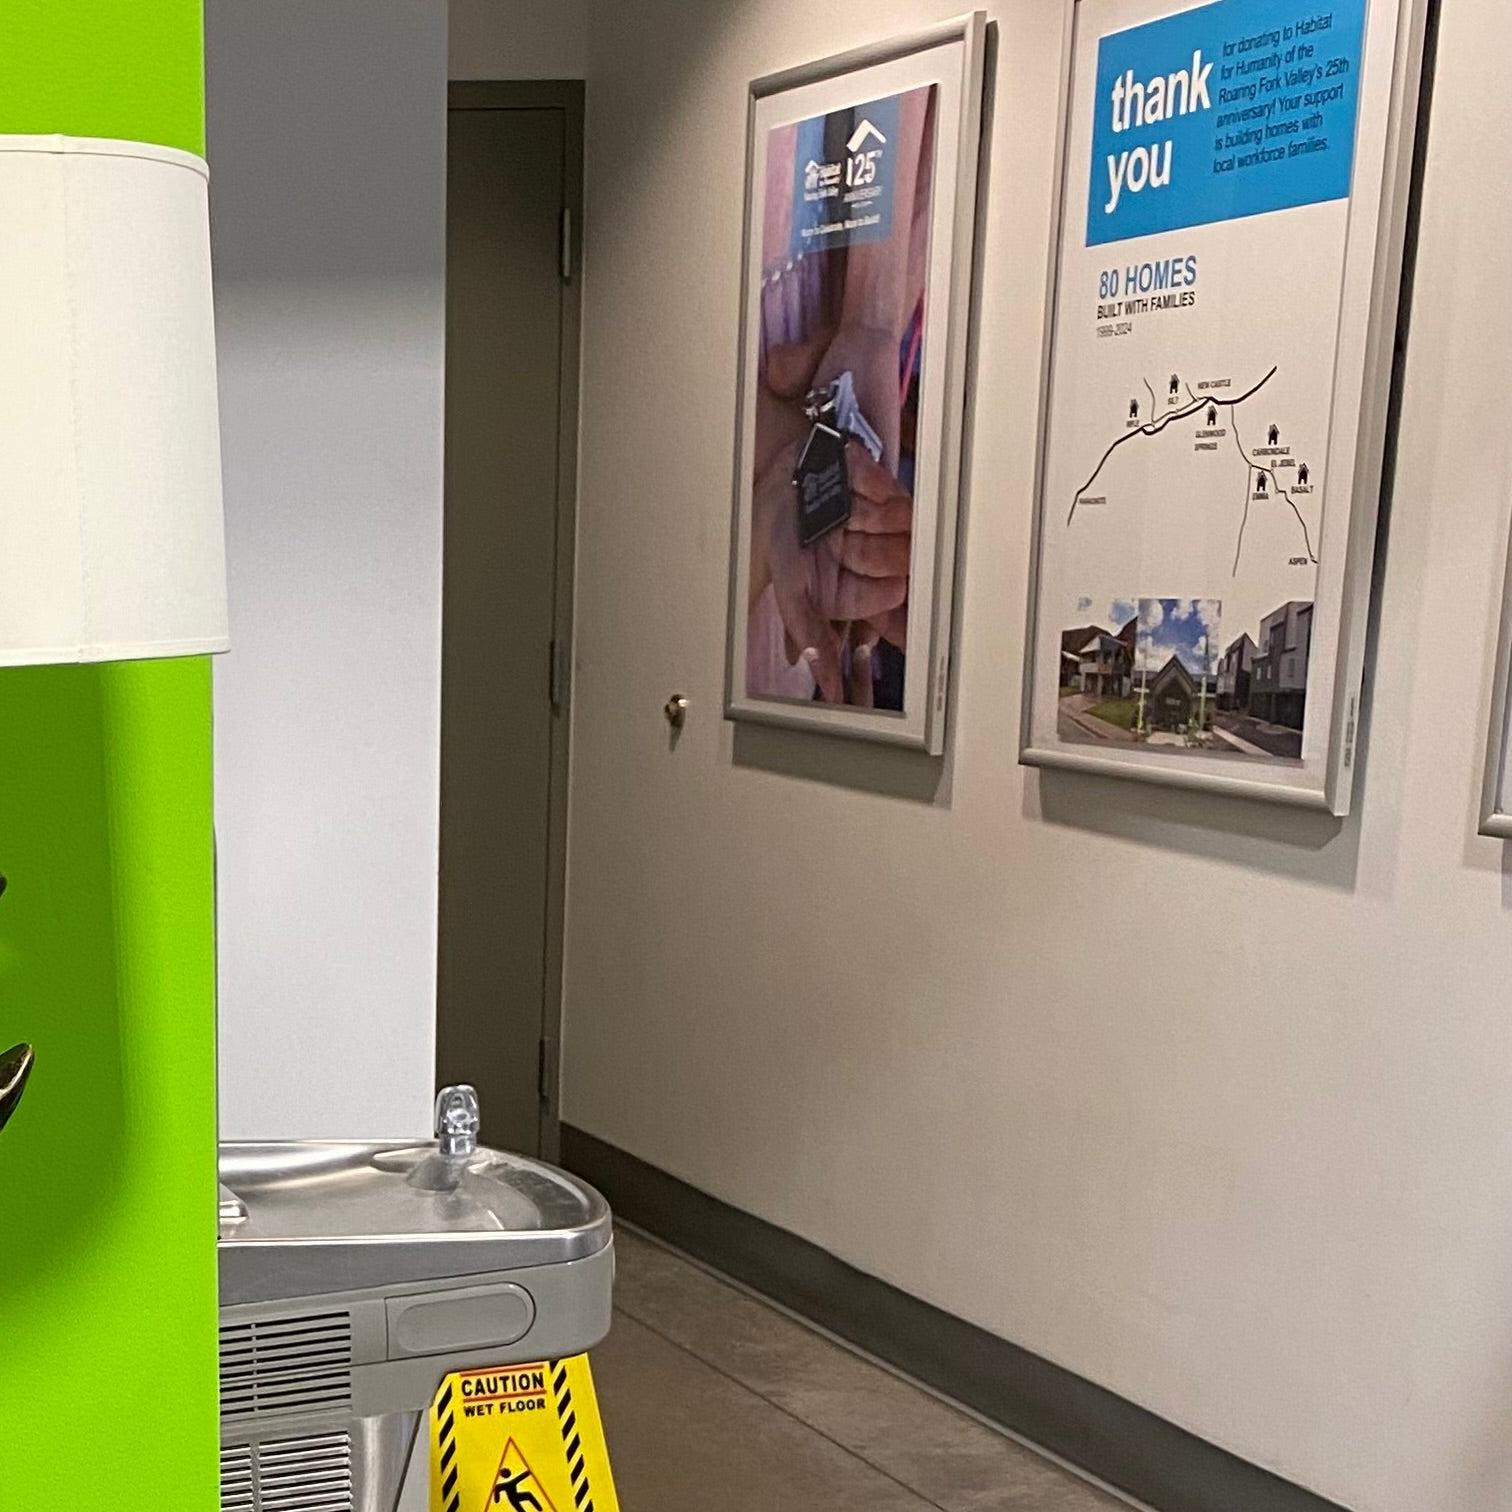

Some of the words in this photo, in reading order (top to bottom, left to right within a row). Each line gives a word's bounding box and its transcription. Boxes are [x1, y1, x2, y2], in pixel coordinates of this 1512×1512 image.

[1222, 41, 1236, 57] for
[1237, 30, 1280, 53] donating
[1282, 25, 1293, 41] to
[1295, 12, 1332, 37] Habitat
[1218, 83, 1257, 105] Roaring
[1259, 73, 1282, 93] Fork
[1284, 64, 1323, 86] Valley's
[1325, 57, 1349, 78] 25th
[1220, 64, 1234, 80] for
[1236, 52, 1282, 76] Humanity
[1284, 45, 1296, 63] of
[1297, 43, 1314, 60] the
[1112, 50, 1214, 133] thank
[1216, 98, 1276, 128] anniversary!
[1276, 95, 1302, 112] Your
[1304, 83, 1344, 108] support
[1214, 135, 1223, 151] is
[1225, 128, 1263, 148] building
[1265, 120, 1299, 140] homes
[1302, 110, 1324, 130] with
[1104, 140, 1173, 214] you
[1212, 154, 1235, 174] local
[1237, 145, 1285, 168] workforce
[1099, 269, 1119, 300] 80
[1124, 255, 1197, 296] HOMES
[1096, 302, 1123, 320] BUILT
[1125, 299, 1148, 316] WITH
[1150, 291, 1196, 312] FAMILIES
[461, 1371, 545, 1397] CAUTION
[463, 1402, 493, 1417] WET
[499, 1398, 546, 1413] FLOOR
